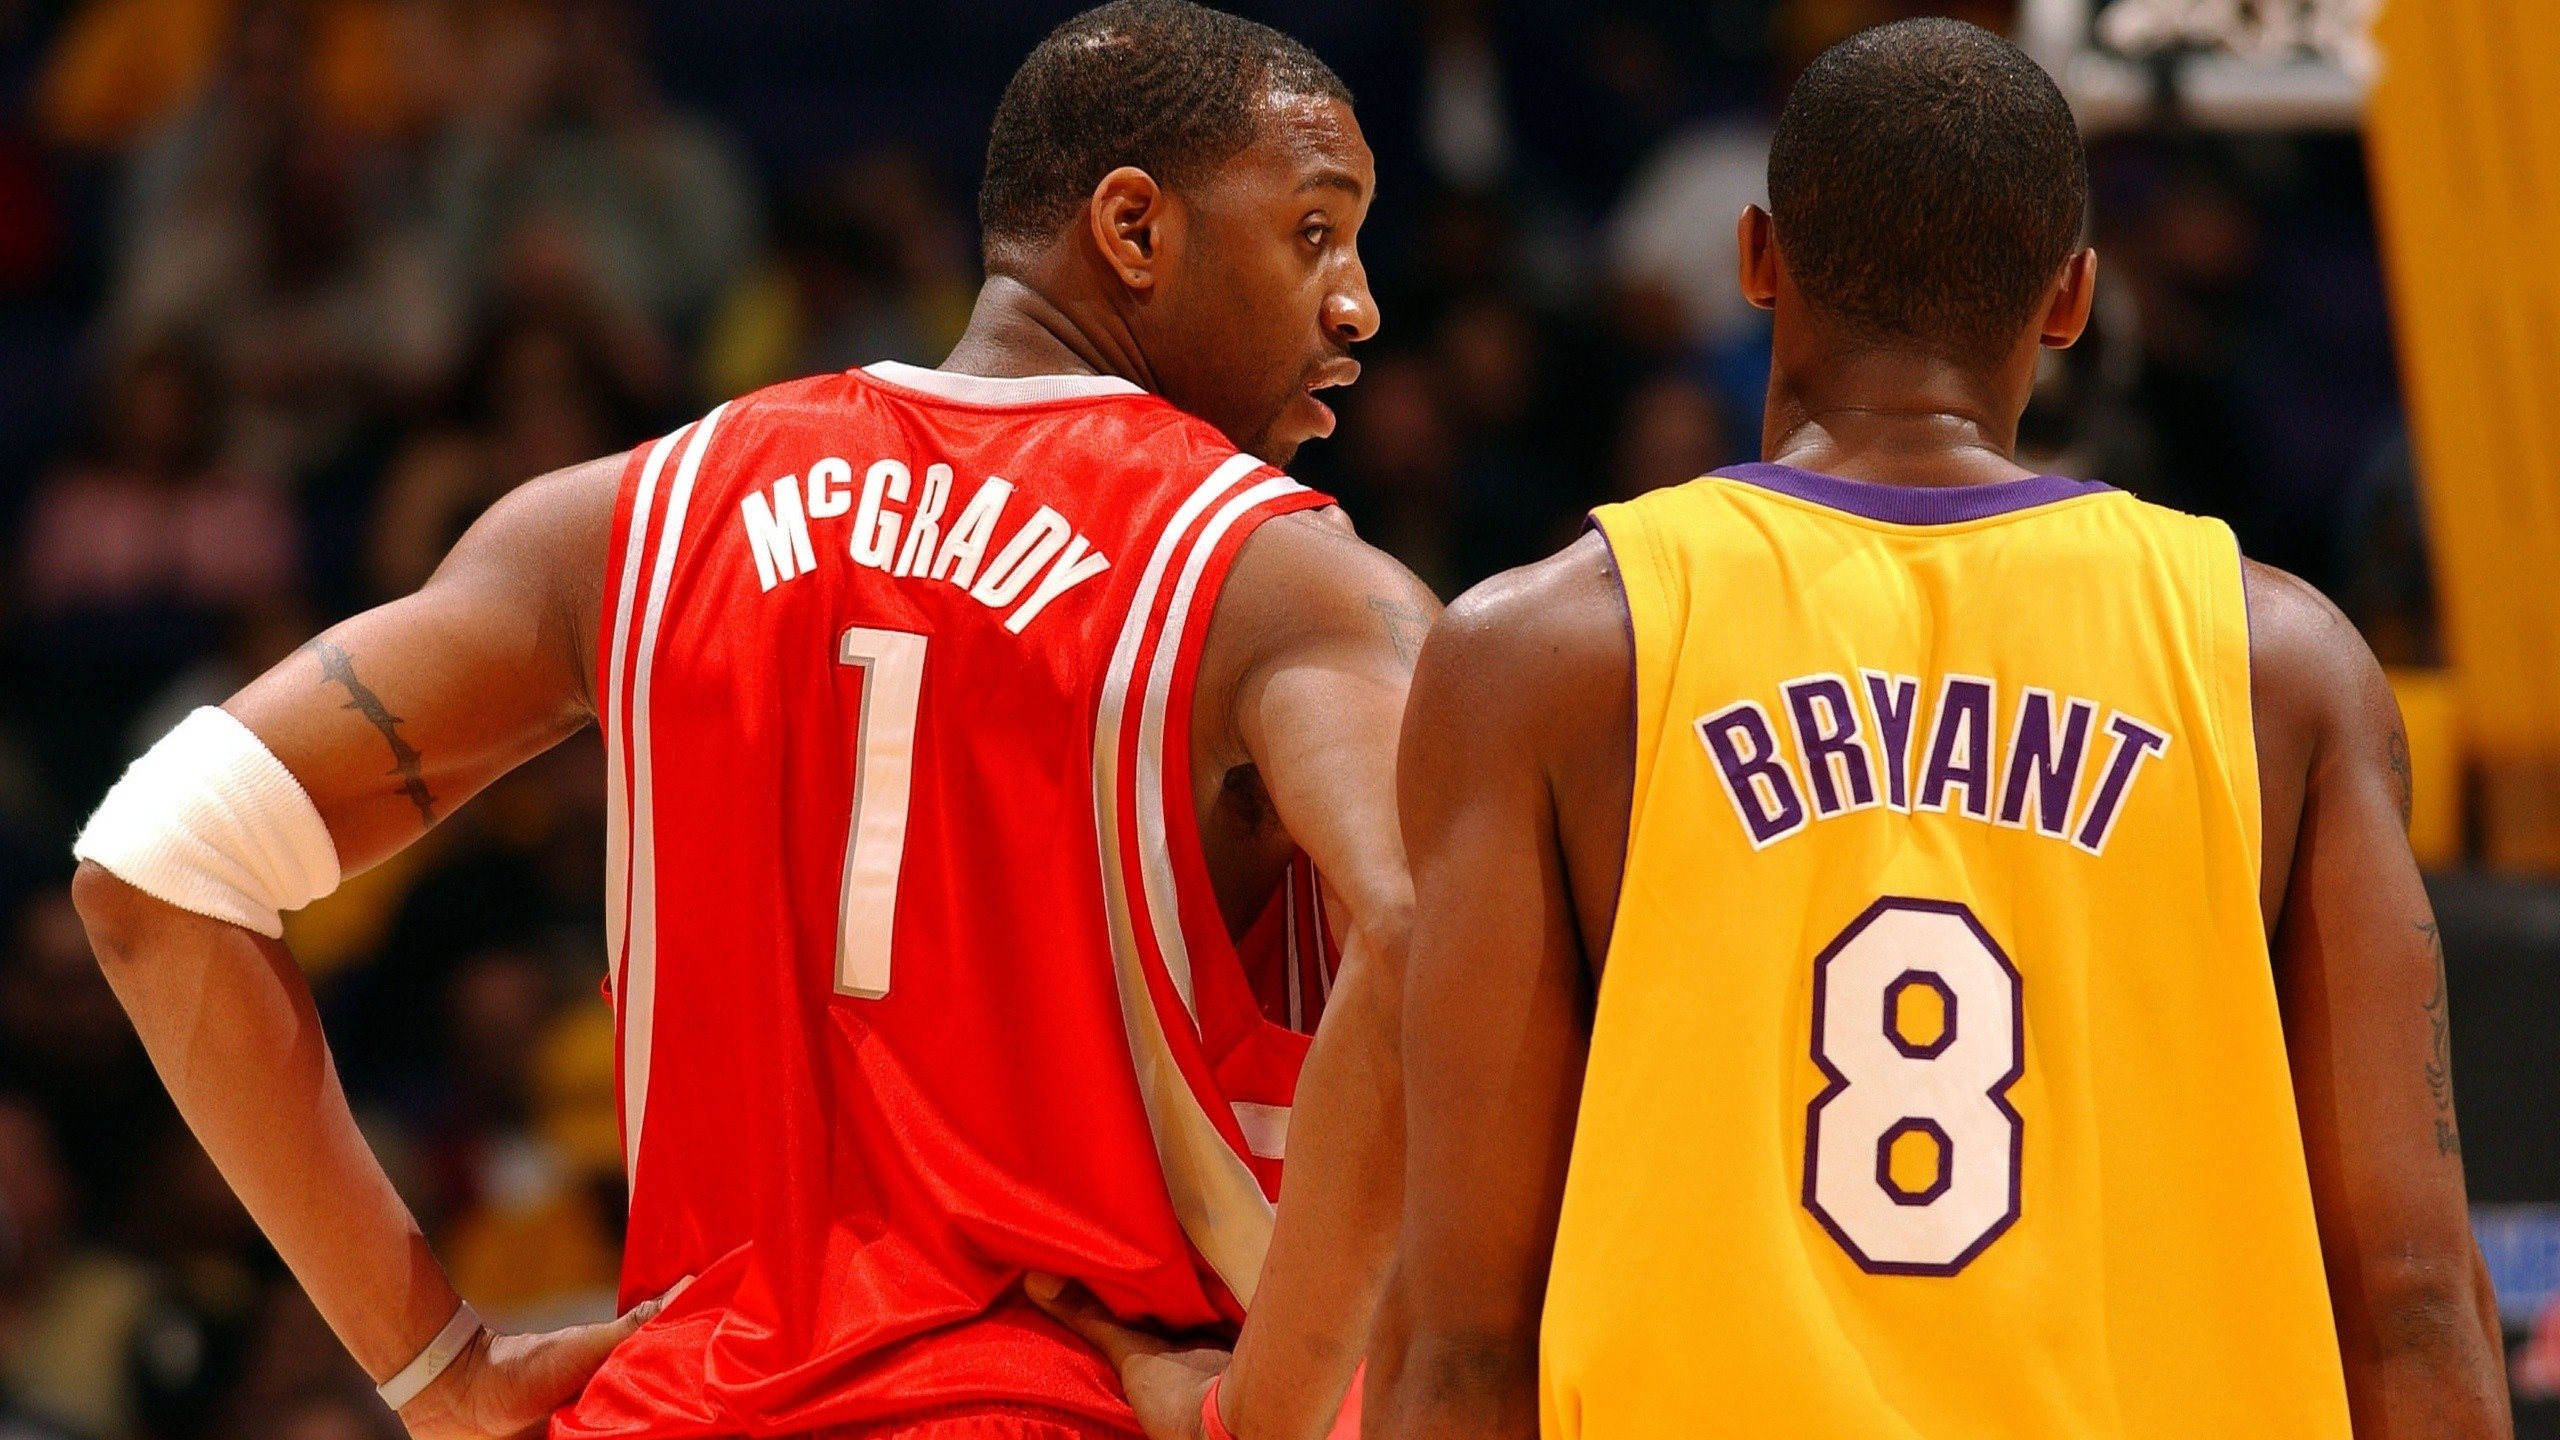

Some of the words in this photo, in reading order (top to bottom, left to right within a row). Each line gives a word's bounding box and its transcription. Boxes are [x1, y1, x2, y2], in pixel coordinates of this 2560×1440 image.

[833, 626, 928, 1000] 1
[1693, 667, 2173, 857] BRYANT
[1801, 895, 2025, 1278] 8
